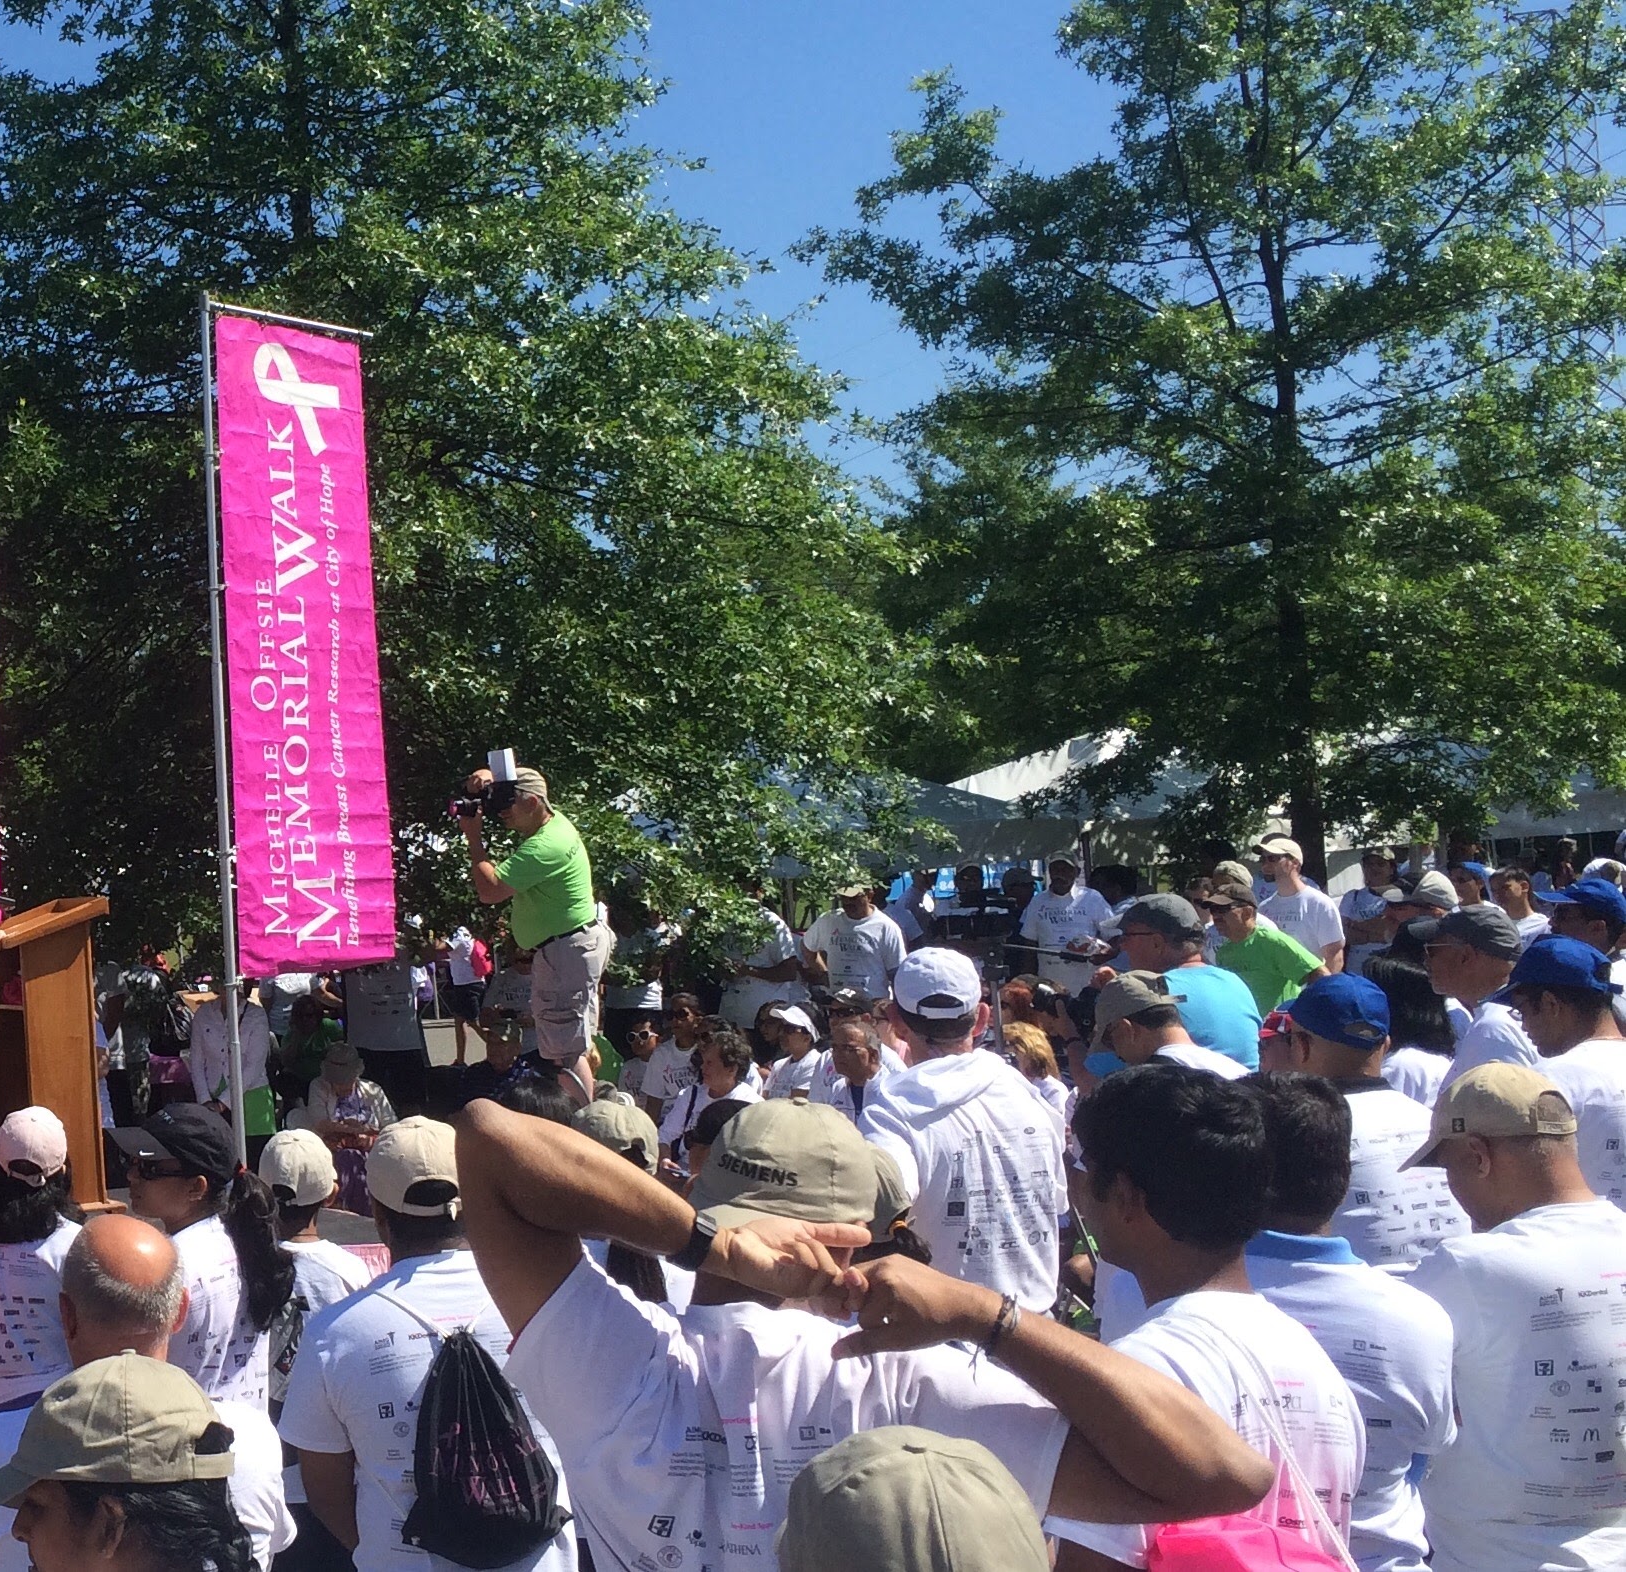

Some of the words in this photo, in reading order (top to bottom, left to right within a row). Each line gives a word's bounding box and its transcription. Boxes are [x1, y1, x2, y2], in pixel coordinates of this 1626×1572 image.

[267, 418, 319, 596] WALK
[319, 464, 339, 515] Hope
[320, 516, 339, 540] of
[325, 545, 341, 587] City
[330, 592, 340, 614] at
[250, 578, 278, 712] OFFSIE
[327, 619, 341, 704] Research
[278, 595, 341, 949] MEMORIAL
[330, 710, 347, 778] Cancer
[262, 743, 296, 936] MICHELLE
[336, 783, 353, 844] Breast
[339, 850, 359, 947] Benefiting
[718, 1153, 798, 1187] SIEMENS
